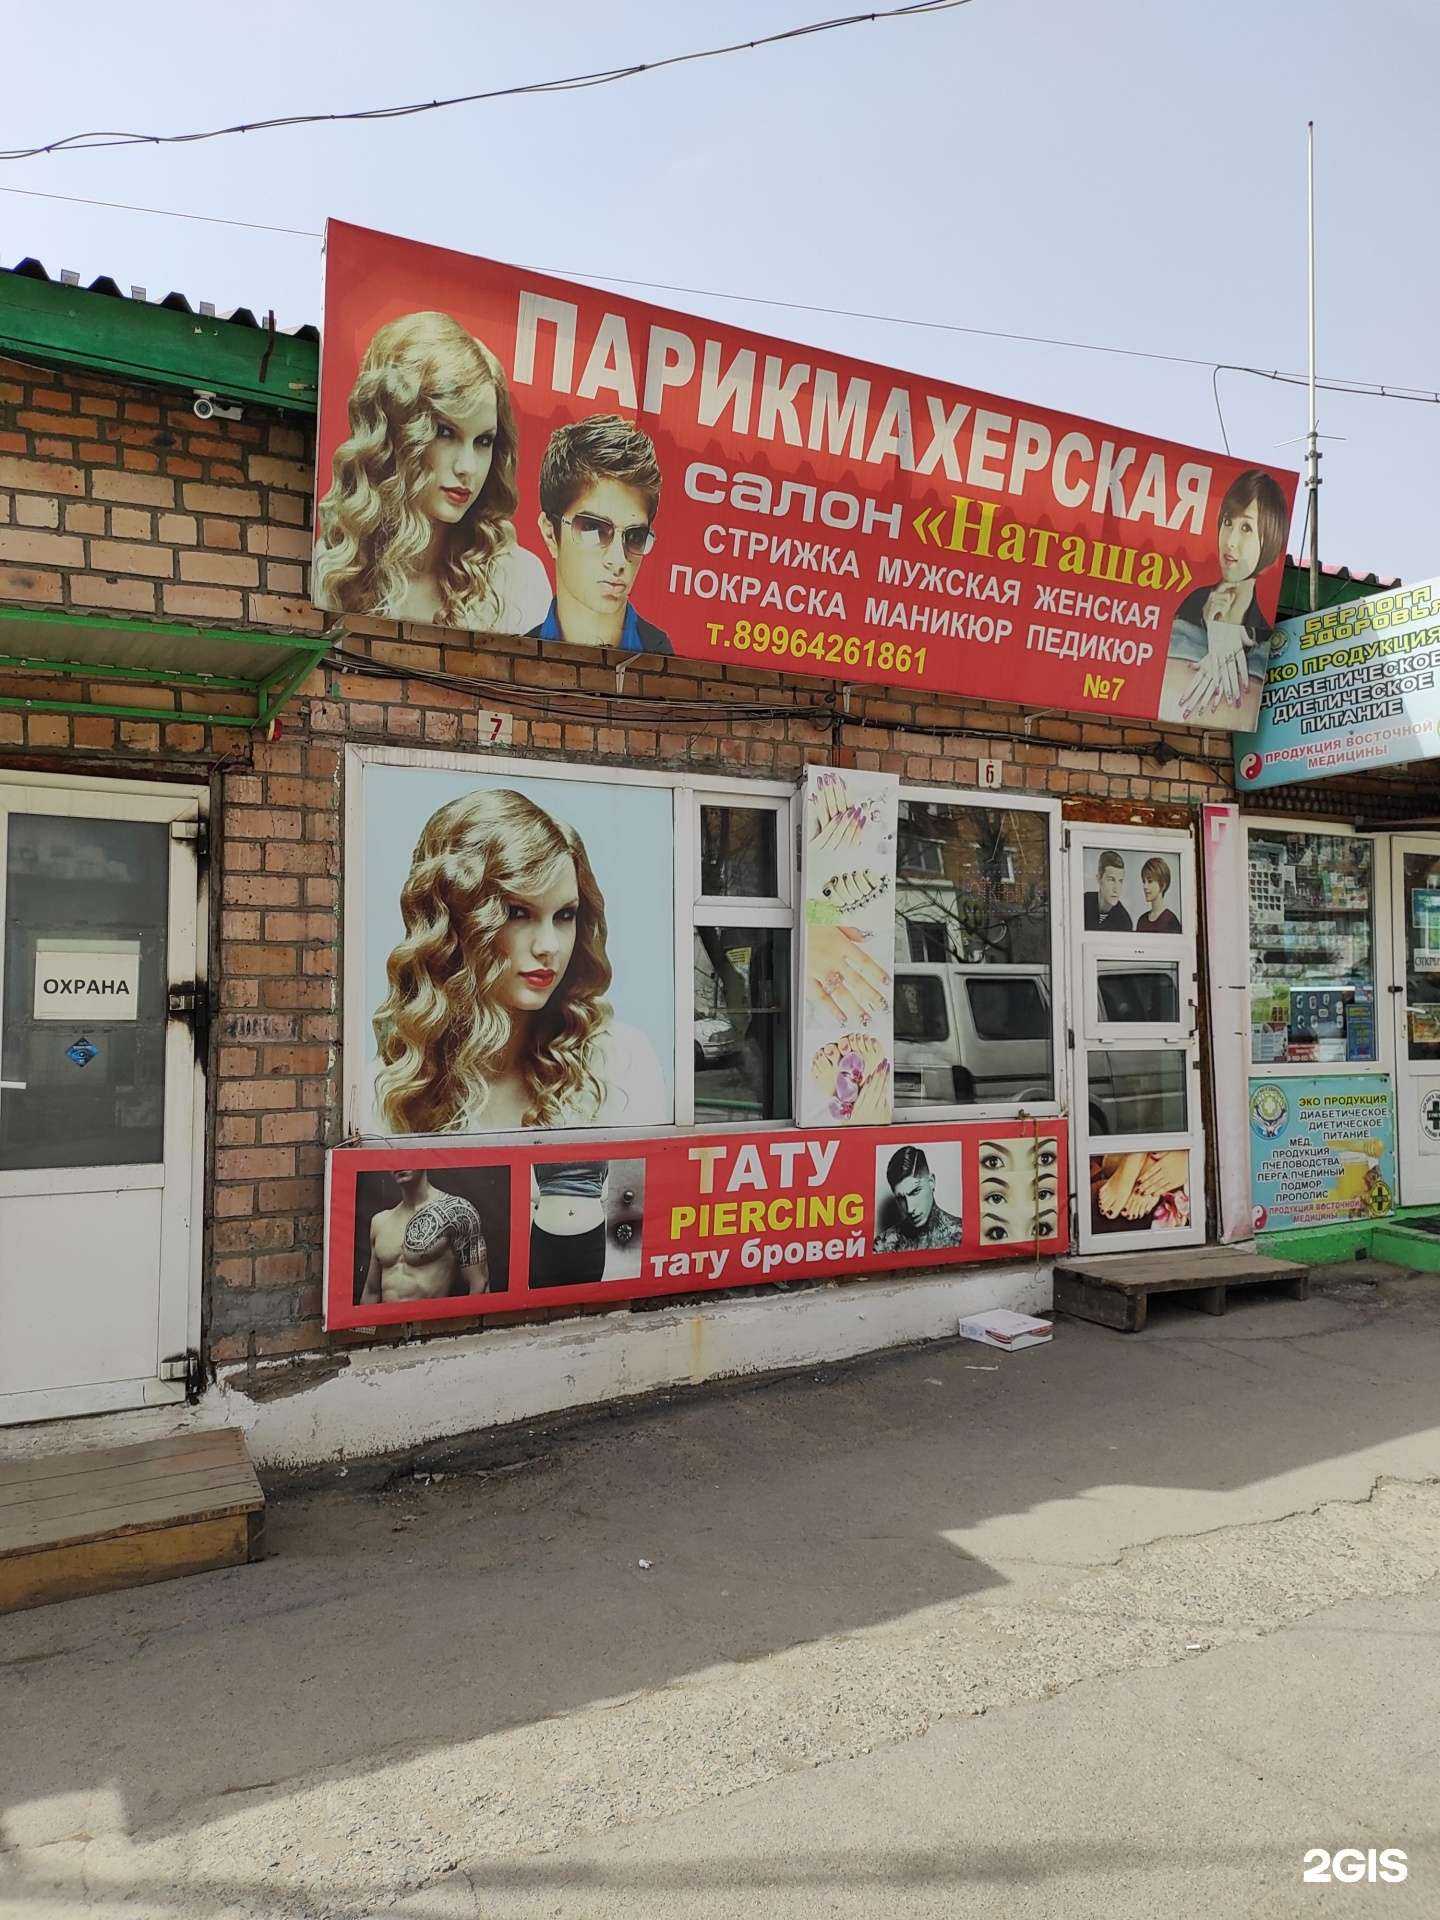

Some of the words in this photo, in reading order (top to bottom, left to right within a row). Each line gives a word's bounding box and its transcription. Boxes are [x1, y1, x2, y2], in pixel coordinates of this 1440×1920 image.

[513, 290, 1213, 535] ПАРИКМАХЕРСКАЯ
[912, 494, 1193, 593] «Наташа»
[703, 524, 860, 578] СТРИЖКА
[877, 556, 1021, 606] МУЖСКАЯ
[1034, 584, 1161, 631] ЖЕНСКАЯ
[669, 564, 847, 620] ПОКРАСКА
[864, 597, 1013, 644] МАНИКЮР
[1026, 624, 1154, 667] ПЕДИКЮР
[1300, 599, 1440, 650] ЗДОРОВЬЯ
[1304, 585, 1431, 633] БЕРЛОГА
[1264, 662, 1299, 686] КО
[1302, 626, 1440, 676] ПРОДУКЦИЯ
[1083, 673, 1125, 702] №7
[1260, 650, 1440, 710] ДИАБЕТИЧЕСКОЕ
[1273, 672, 1434, 726] ДИЕТИЧЕСКОЕ
[490, 717, 503, 742] 7
[1301, 698, 1403, 735] ПИТАНИЕ
[1264, 740, 1341, 764] ПРОДУКЦИЯ
[1346, 720, 1433, 747] ВОСТОЧНОЙ
[1308, 745, 1388, 769] МЕДИЦИНЫ
[43, 978, 130, 996] ОХРАНА
[1299, 1097, 1321, 1107] ЭКО
[1324, 1095, 1388, 1106] ПРОДУКЦИЯ
[1300, 1107, 1388, 1120] ДИАБЕТИЧЕСКОЕ
[1308, 1118, 1383, 1131] ДИЕТИЧЕСКОЕ
[1323, 1130, 1369, 1140] ПИТАНИЕ
[1272, 1147, 1330, 1159] ПРОДУКЦИЯ
[1269, 1204, 1315, 1215] ПРОДУКЦИЯ
[1275, 1191, 1329, 1202] ПРОПОЛИС
[670, 1194, 864, 1240] PIERCING
[650, 1249, 730, 1280] тату
[740, 1230, 866, 1274] бровей
